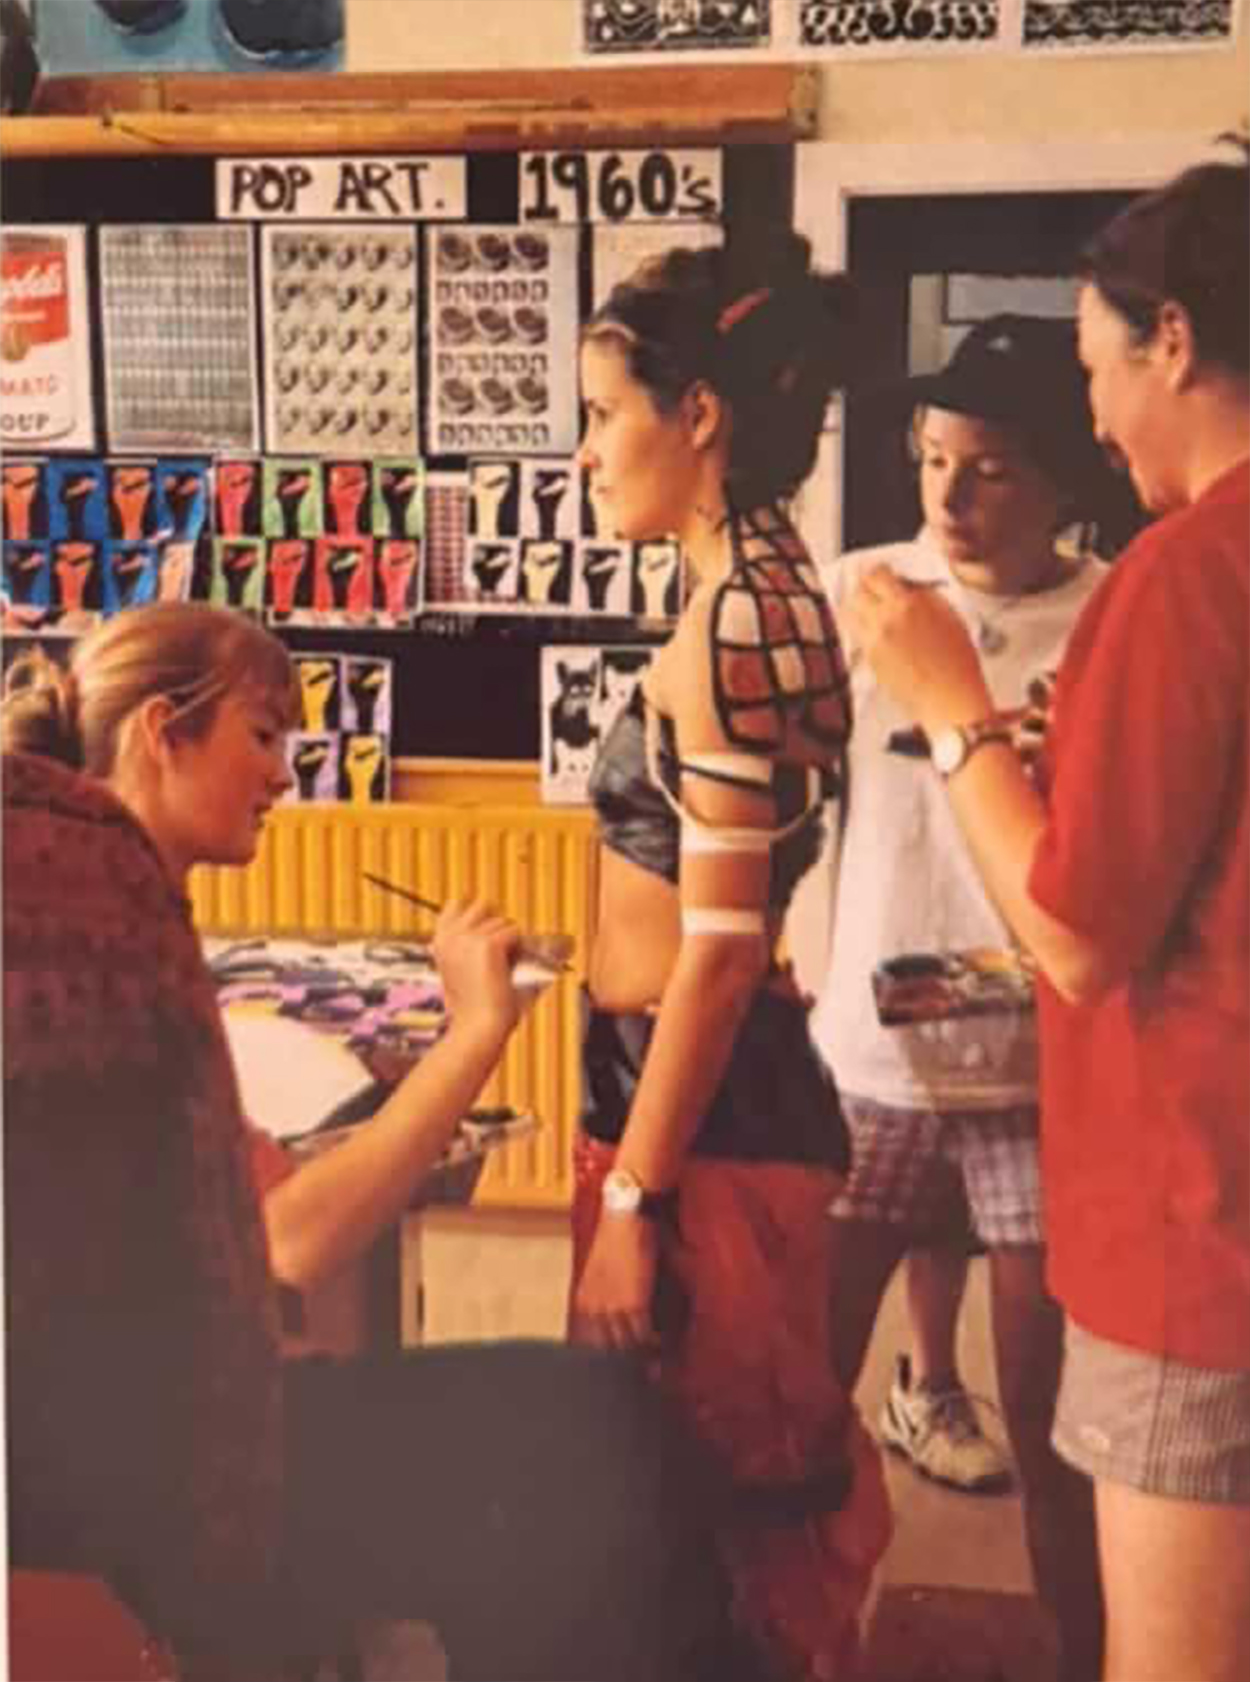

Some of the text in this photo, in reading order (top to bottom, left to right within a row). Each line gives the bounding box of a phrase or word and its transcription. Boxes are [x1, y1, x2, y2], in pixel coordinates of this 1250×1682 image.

[230, 161, 445, 215] POP ART.
[524, 152, 717, 222] 1960's
